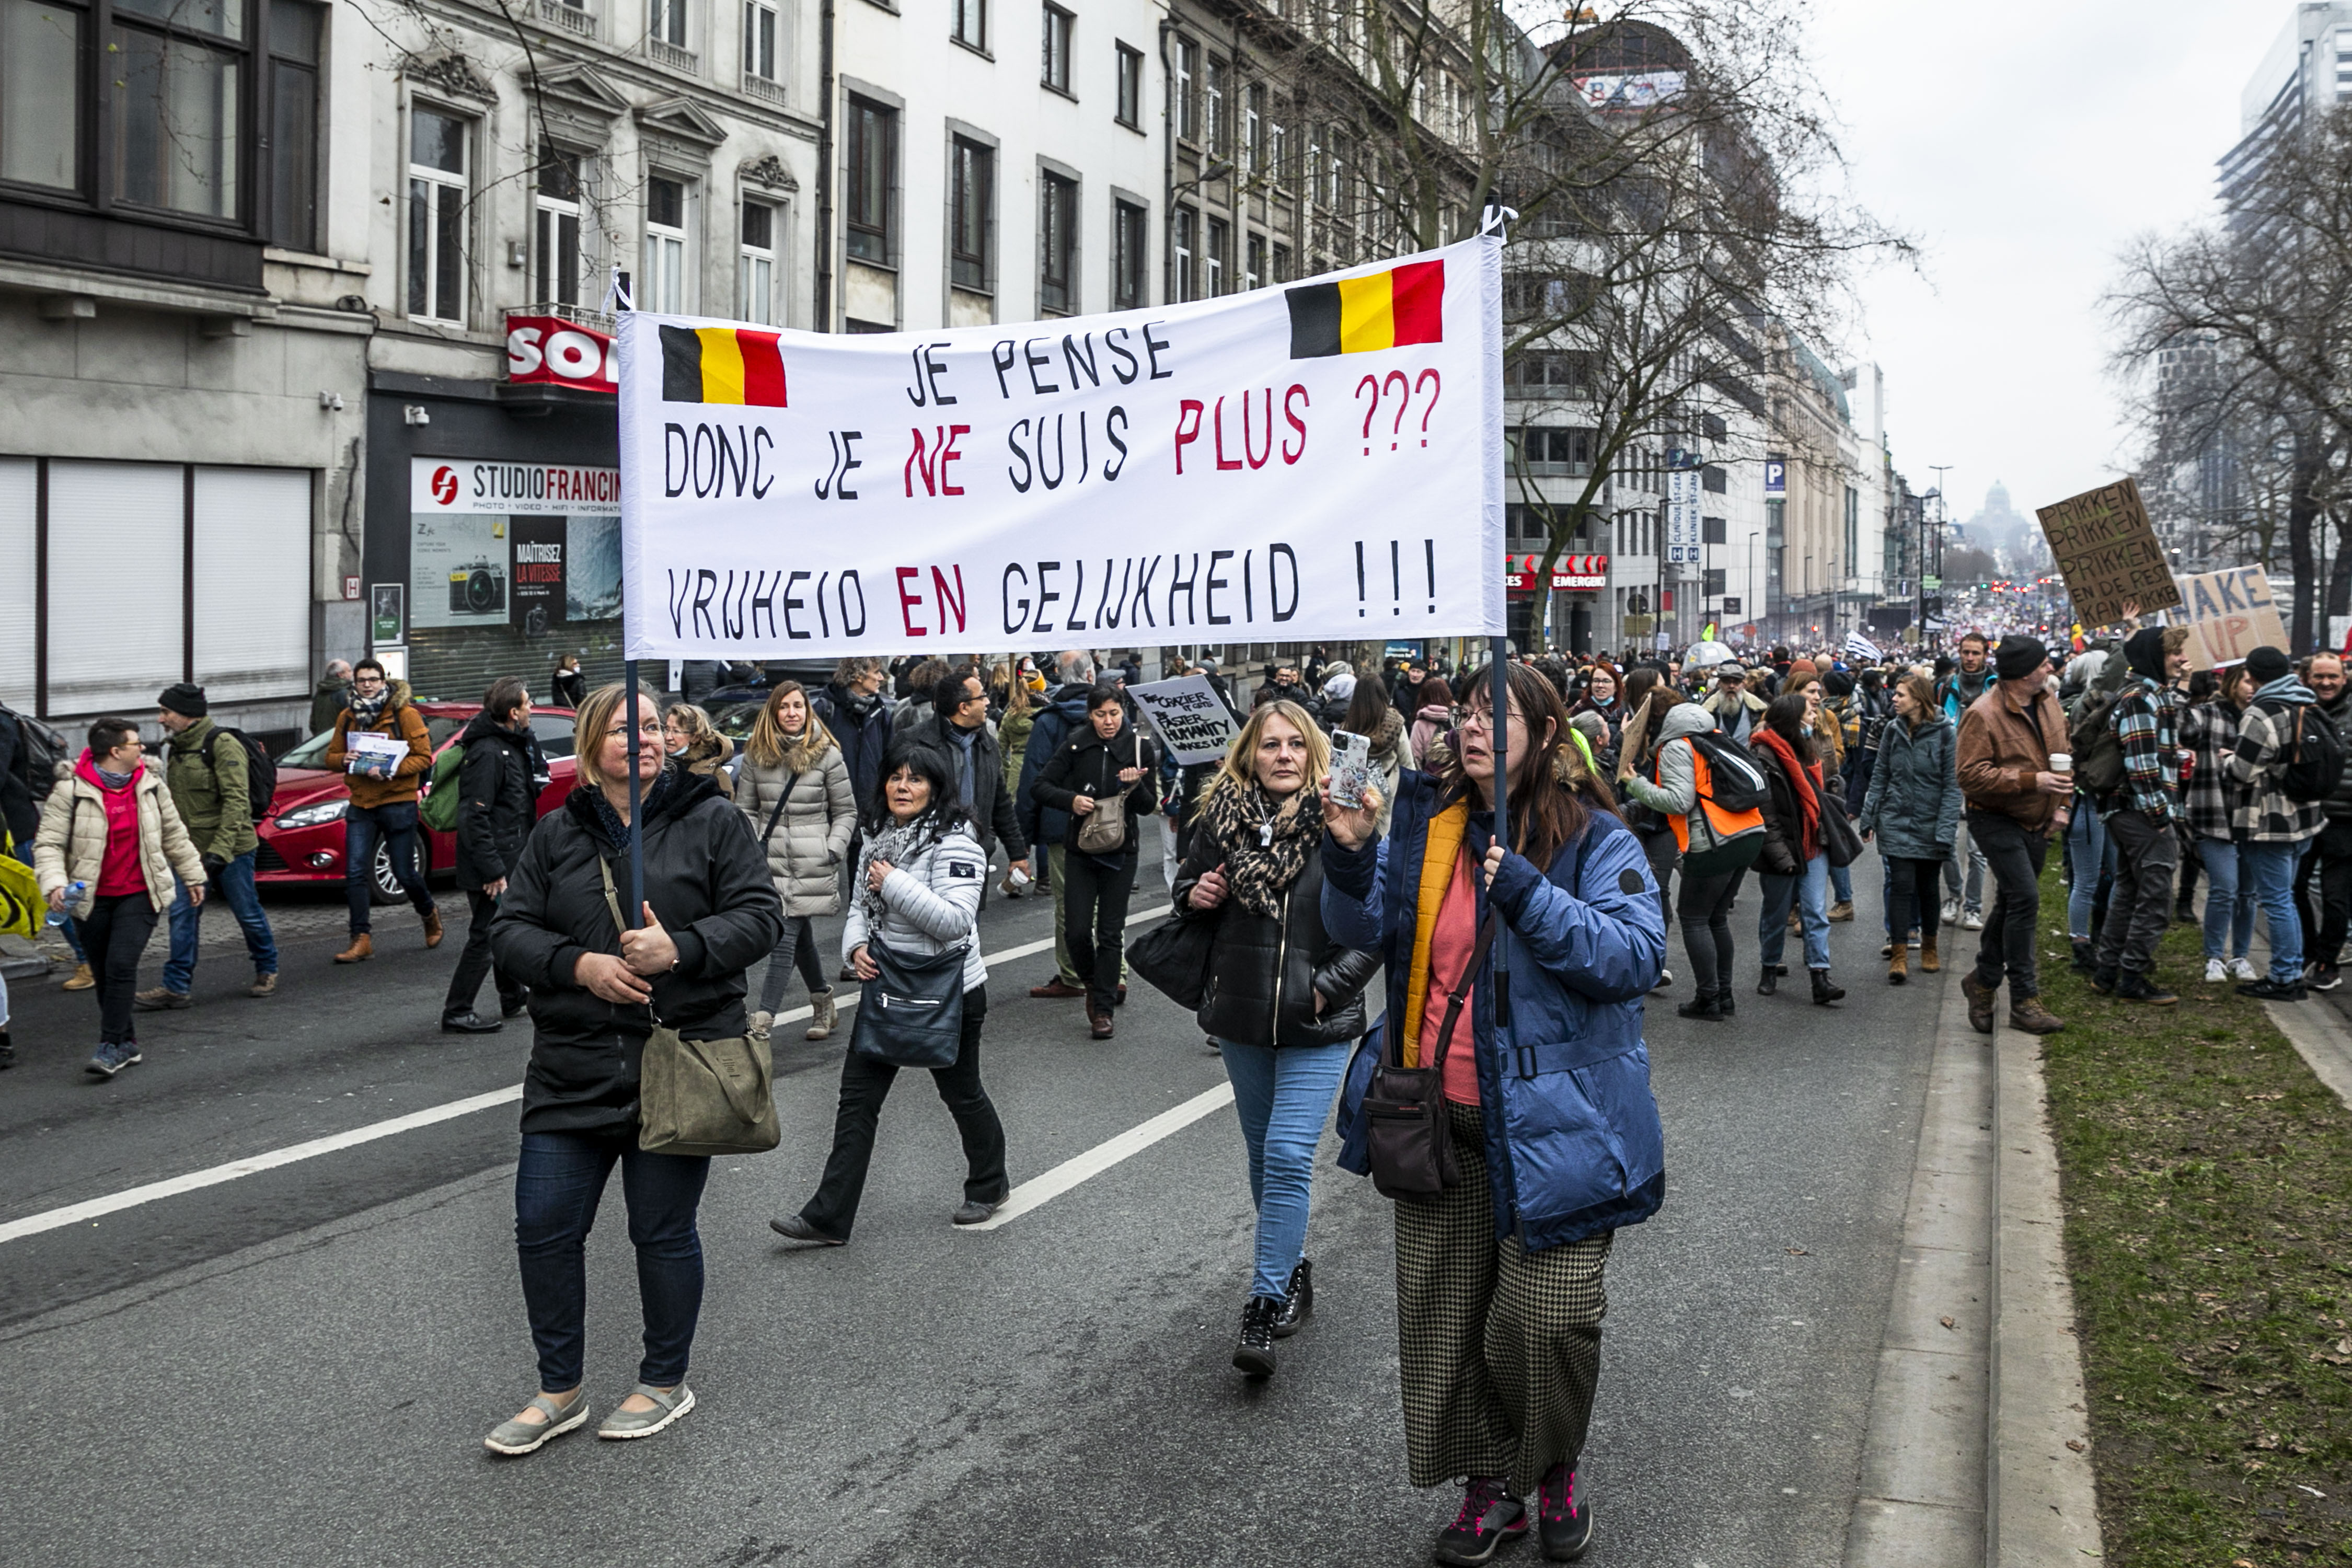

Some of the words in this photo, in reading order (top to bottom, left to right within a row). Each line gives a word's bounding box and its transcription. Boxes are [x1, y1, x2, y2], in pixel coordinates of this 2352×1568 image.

[907, 342, 958, 407] JE
[991, 320, 1173, 399] PENSE
[665, 422, 775, 500] DONC
[814, 431, 862, 500] JE
[904, 424, 971, 498] NE
[1008, 406, 1128, 493] SUIS
[1175, 383, 1310, 475] PLUS
[1355, 368, 1441, 456] ???
[1768, 464, 1783, 484] P
[517, 540, 561, 562] MAÎTRISEZ
[349, 581, 357, 595] H
[516, 564, 527, 582] LA
[527, 564, 560, 582] VITESSE
[2071, 585, 2095, 604] EN
[2099, 578, 2126, 597] DE
[2129, 563, 2169, 589] REST
[667, 568, 867, 640] VRIJHEID
[896, 564, 965, 637] EN
[1002, 543, 1299, 635] GELIJKHEID
[2170, 569, 2271, 624] WAKE
[2199, 616, 2248, 662] UP
[1157, 713, 1210, 729] FASTER
[1210, 737, 1226, 747] UP
